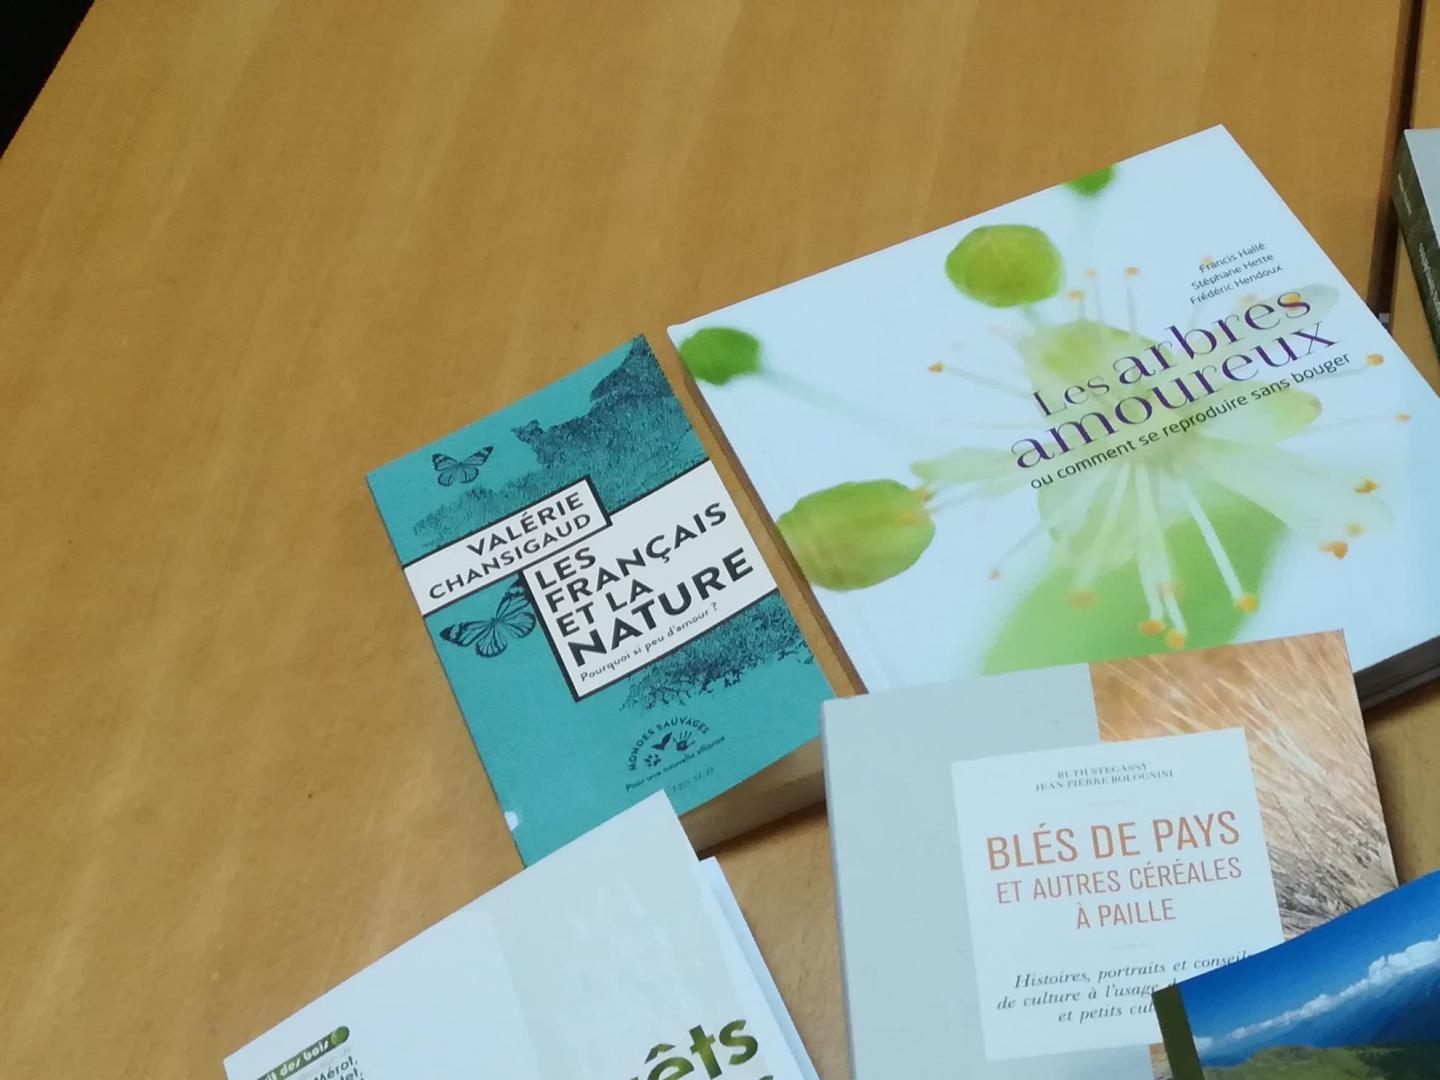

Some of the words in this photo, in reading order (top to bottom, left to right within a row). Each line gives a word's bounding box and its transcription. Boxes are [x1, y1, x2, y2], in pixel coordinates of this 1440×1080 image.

[1199, 254, 1237, 272] Francis
[1032, 374, 1110, 417] Les
[1112, 291, 1311, 385] arbres
[1010, 321, 1340, 469] amoureux
[1031, 473, 1054, 489] ou
[1057, 441, 1136, 479] comment
[1139, 431, 1160, 446] se
[1162, 396, 1248, 438] reproduire
[1251, 378, 1290, 401] sans
[1292, 353, 1350, 384] bouger
[465, 492, 584, 557] VALÉRIE
[428, 512, 591, 600] CHANSIGAUD
[534, 546, 598, 590] LES
[543, 502, 728, 614] FRANÇAIS
[555, 604, 594, 638] ET
[611, 579, 653, 612] LA
[567, 547, 753, 667] NATURE
[580, 654, 631, 682] Pourquoi
[633, 646, 642, 655] si
[645, 636, 665, 652] peu
[667, 610, 709, 638] d'amour
[711, 602, 717, 611] ?
[987, 822, 1078, 871] BLÉS
[1091, 821, 1140, 860] DE
[1153, 810, 1240, 852] PAYS
[997, 881, 1022, 904] ET
[1033, 870, 1121, 900] AUTRES
[1130, 857, 1242, 890] CÉRÉALES
[1076, 903, 1091, 929] À
[1098, 898, 1176, 926] PAILLE
[997, 997, 1016, 1010] de
[1023, 991, 1081, 1008] culture
[1088, 987, 1097, 998] à
[1015, 972, 1091, 988] Histoires,
[1098, 964, 1166, 983] portraits
[1173, 961, 1187, 971] et
[1194, 950, 1251, 969] conseil
[1058, 1012, 1072, 1022] et
[1080, 1003, 1123, 1023] petits
